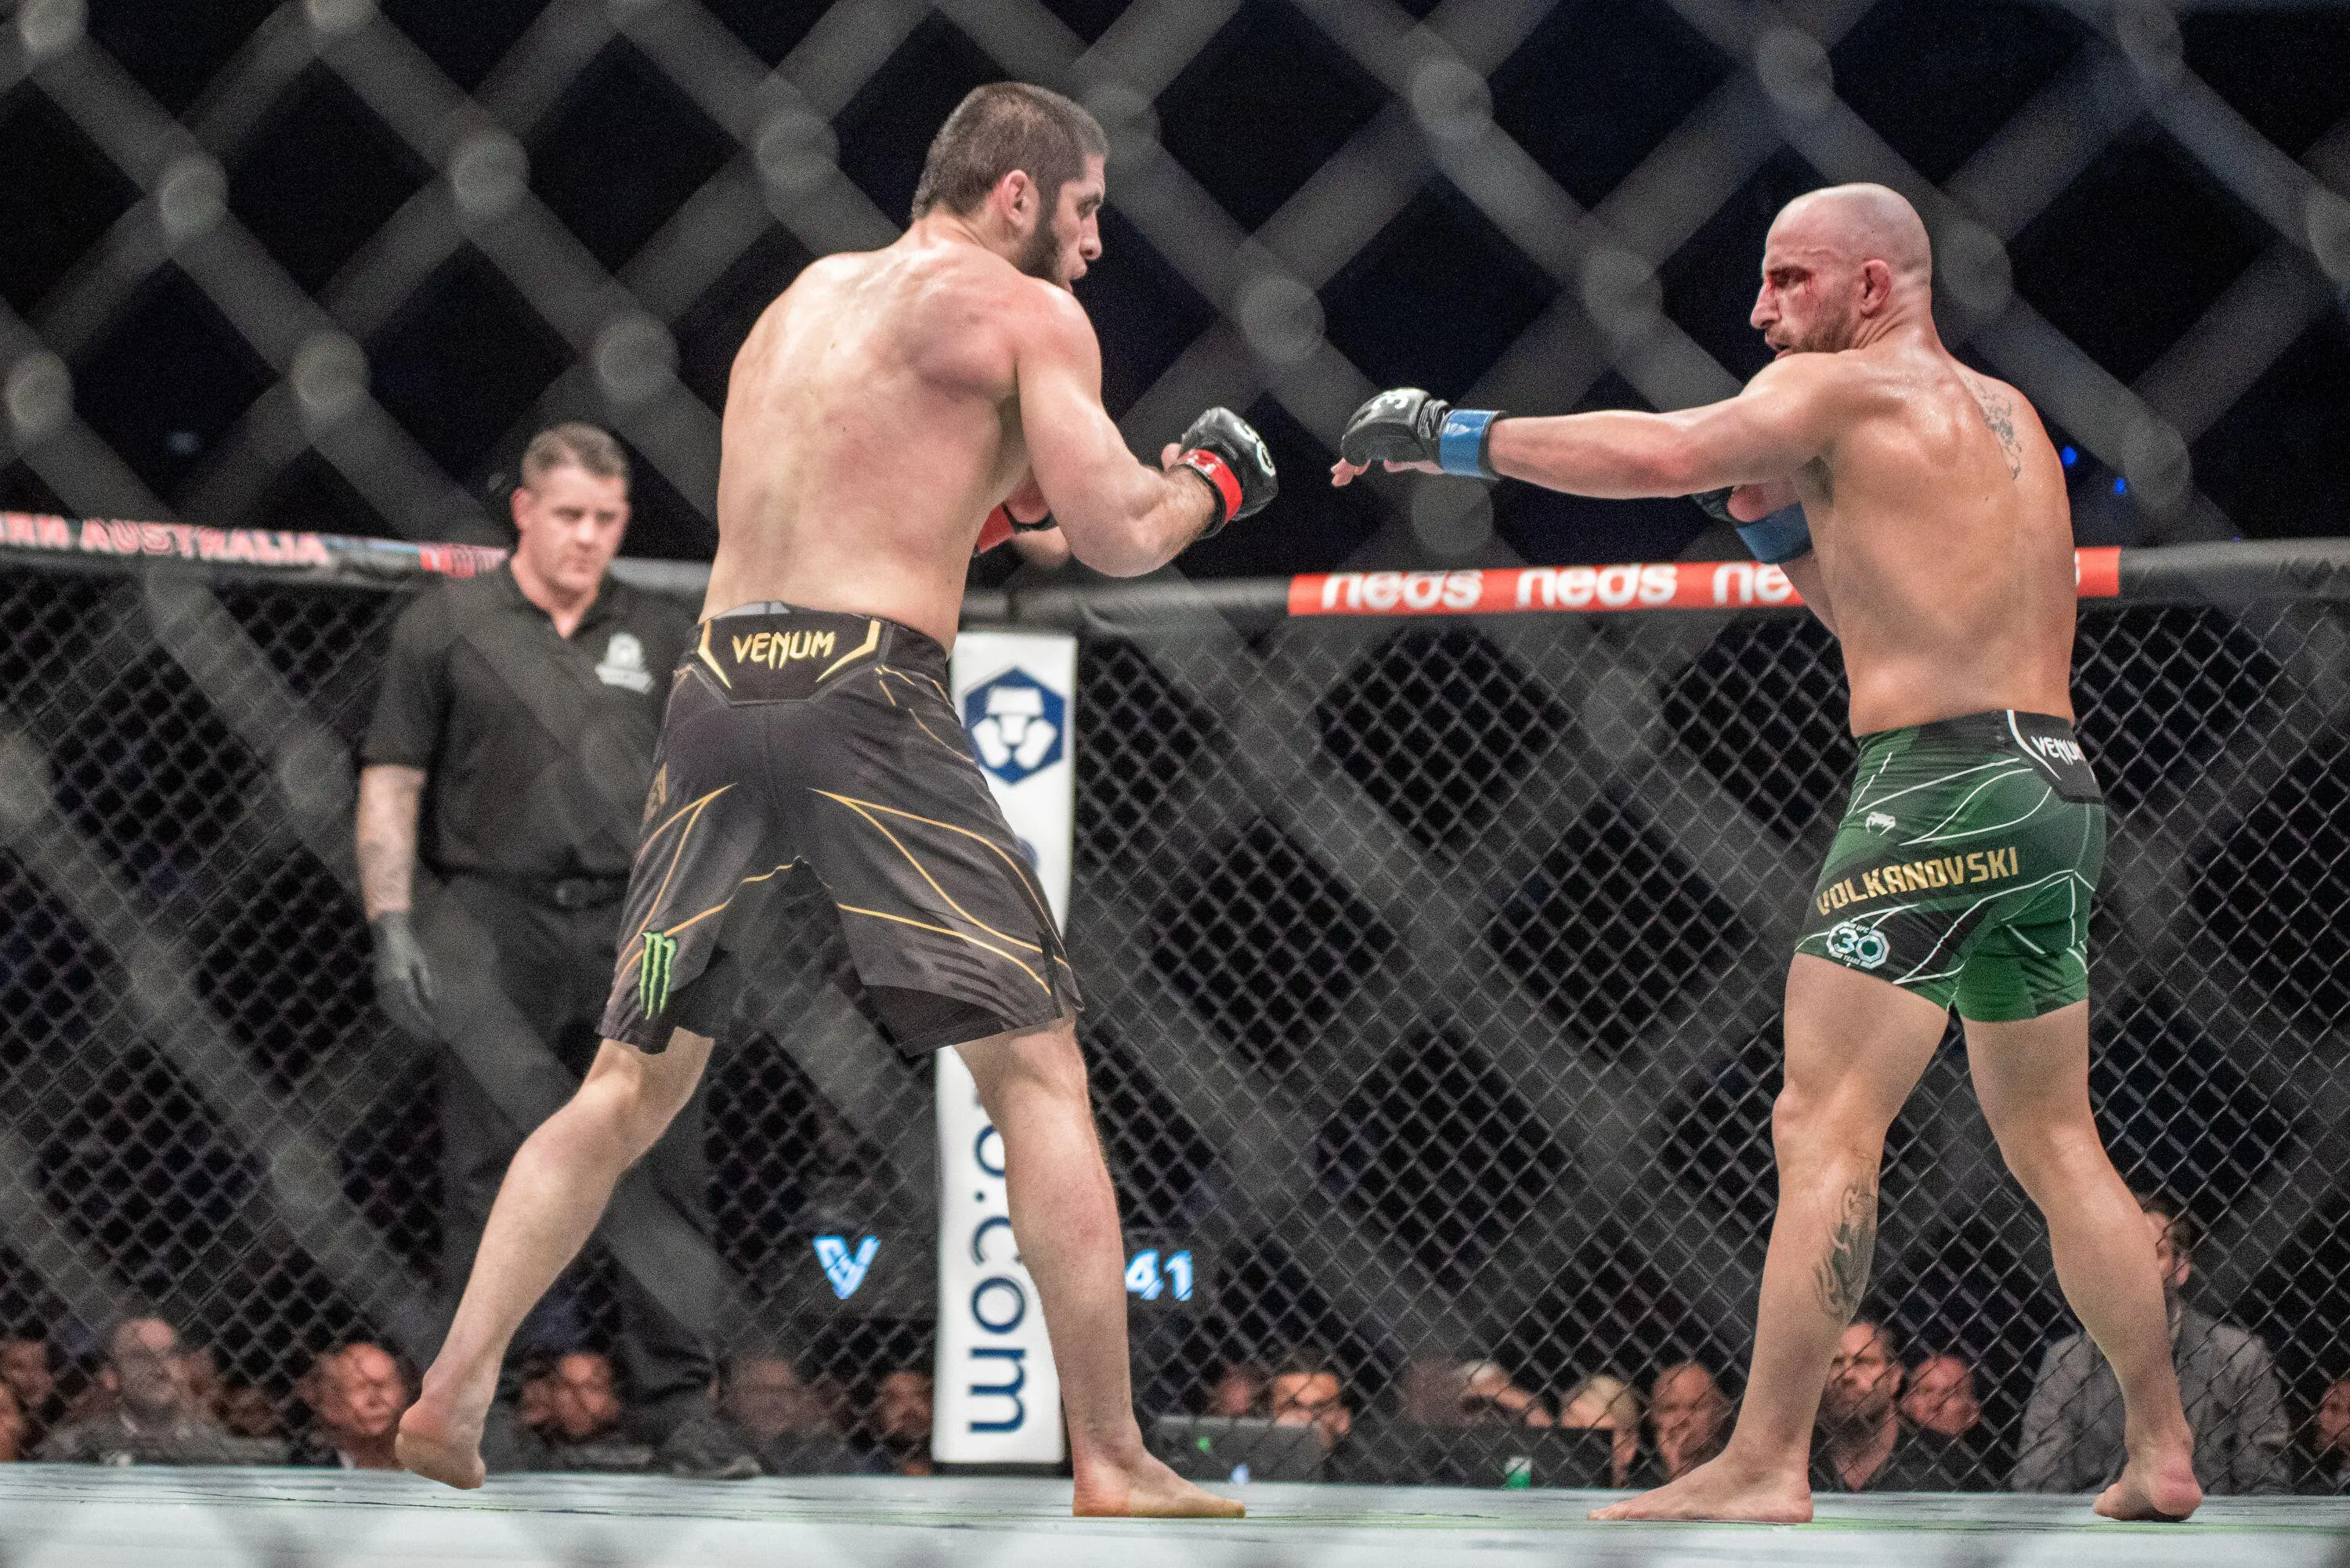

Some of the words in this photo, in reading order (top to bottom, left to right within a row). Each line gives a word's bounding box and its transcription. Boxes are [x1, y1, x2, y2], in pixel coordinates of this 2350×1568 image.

[79, 518, 330, 565] AUSTRALIA
[1320, 569, 1484, 609] neds
[1514, 564, 1678, 607] neds
[1712, 562, 1792, 605] ne
[732, 630, 836, 669] VENUM
[1816, 847, 2019, 916] VOLKANOVSKI
